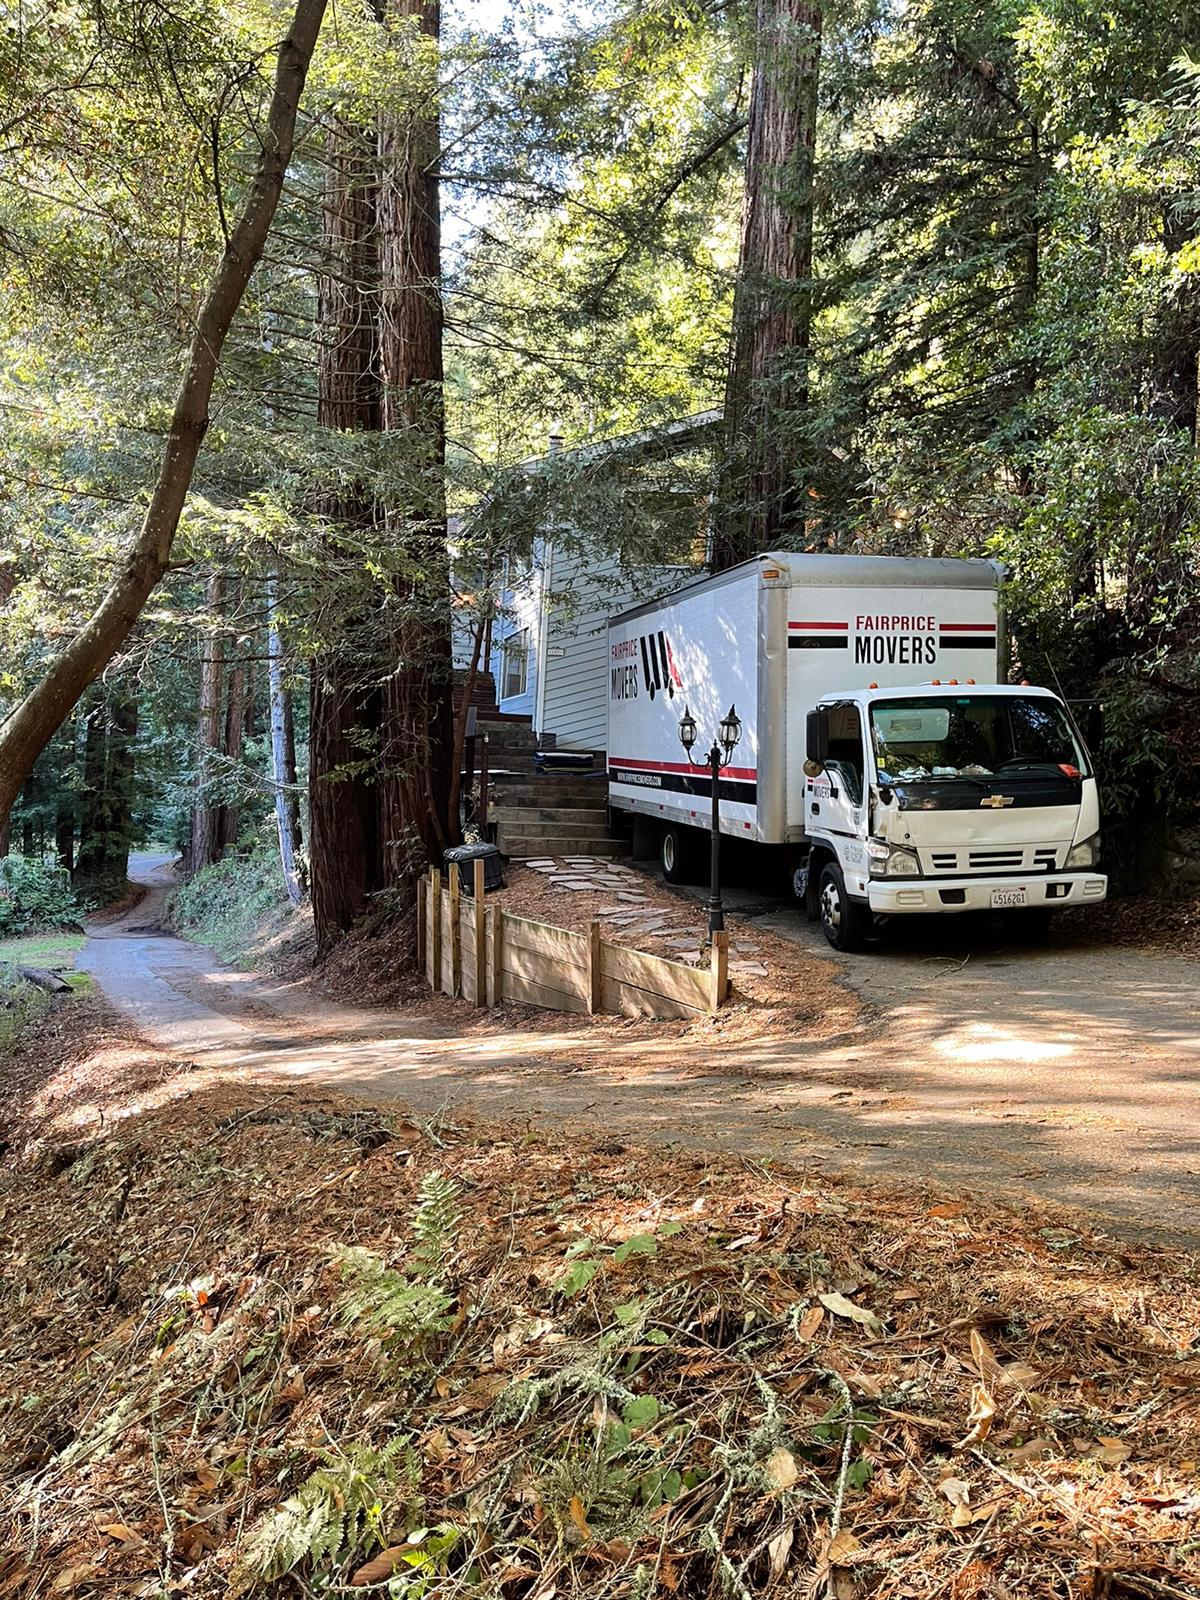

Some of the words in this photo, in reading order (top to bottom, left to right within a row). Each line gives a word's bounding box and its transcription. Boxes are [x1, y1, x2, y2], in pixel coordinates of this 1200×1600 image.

[856, 615, 936, 631] FAIRPRICE
[611, 638, 638, 661] FAIRPRICE
[855, 635, 936, 665] MOVERS
[611, 664, 638, 700] MOVERS
